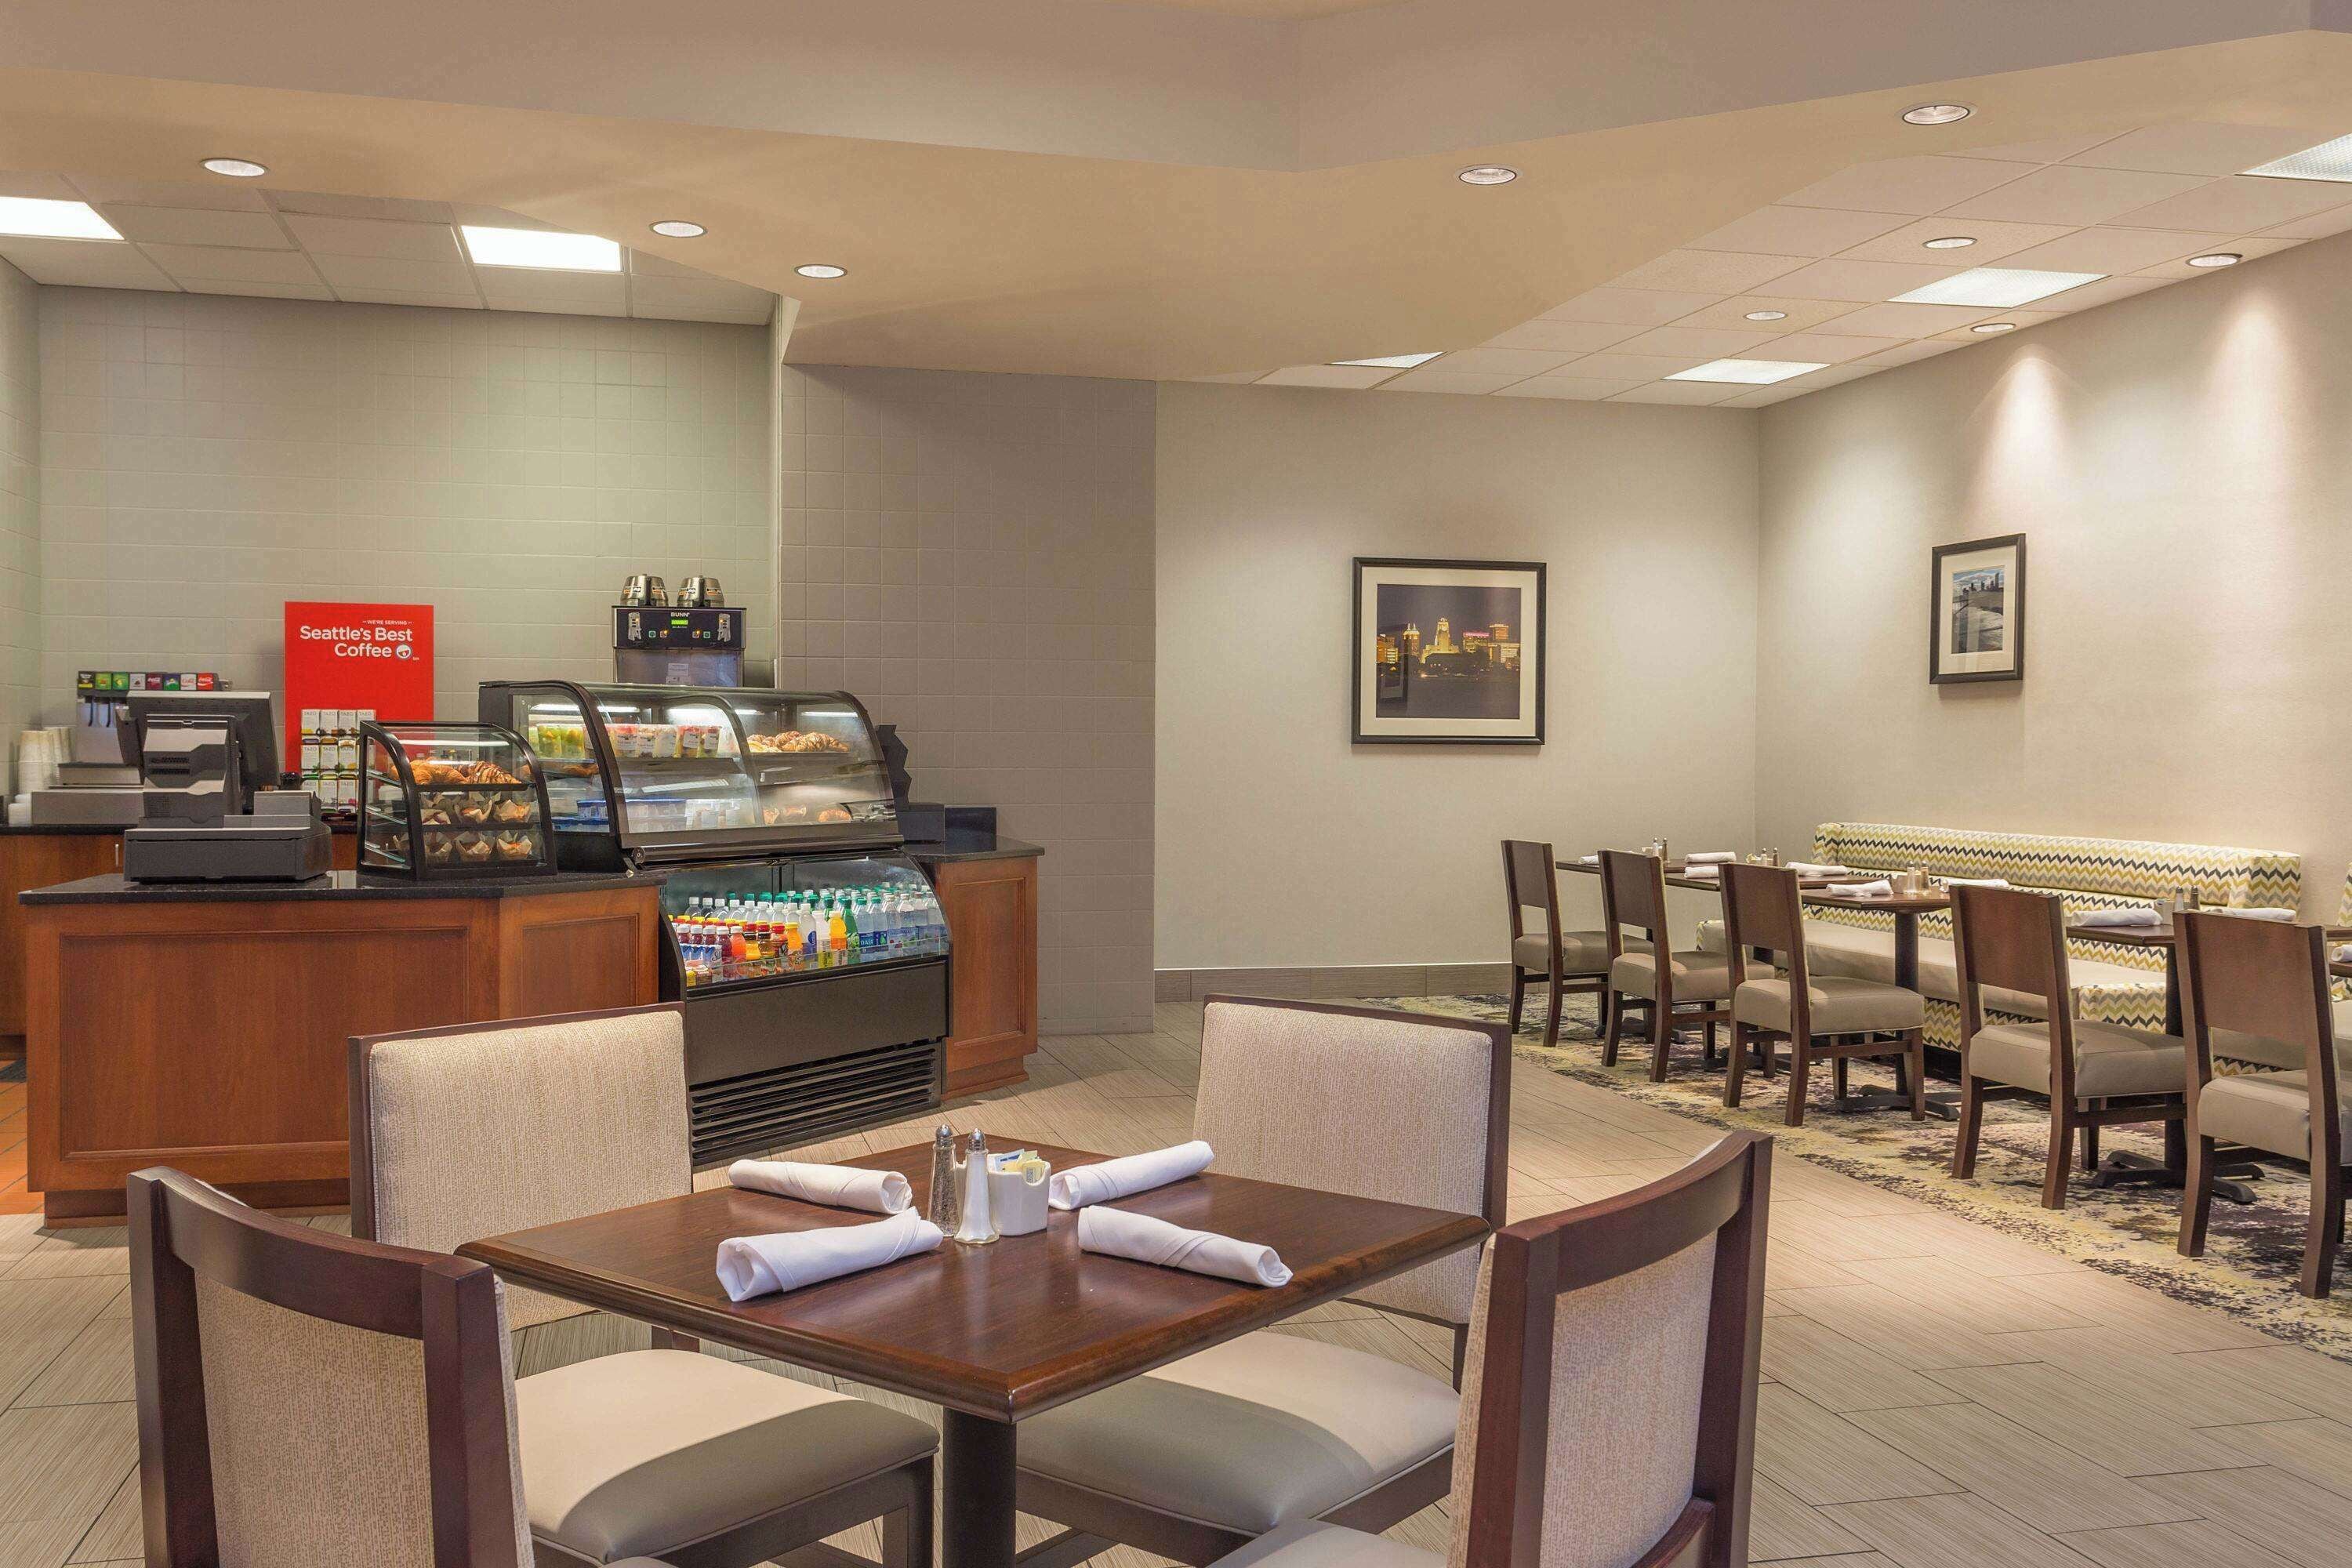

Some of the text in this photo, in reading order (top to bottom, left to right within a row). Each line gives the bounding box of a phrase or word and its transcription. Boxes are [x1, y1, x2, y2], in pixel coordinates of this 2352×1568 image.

[299, 625, 413, 641] Seattle's Best
[334, 642, 392, 658] Coffee
